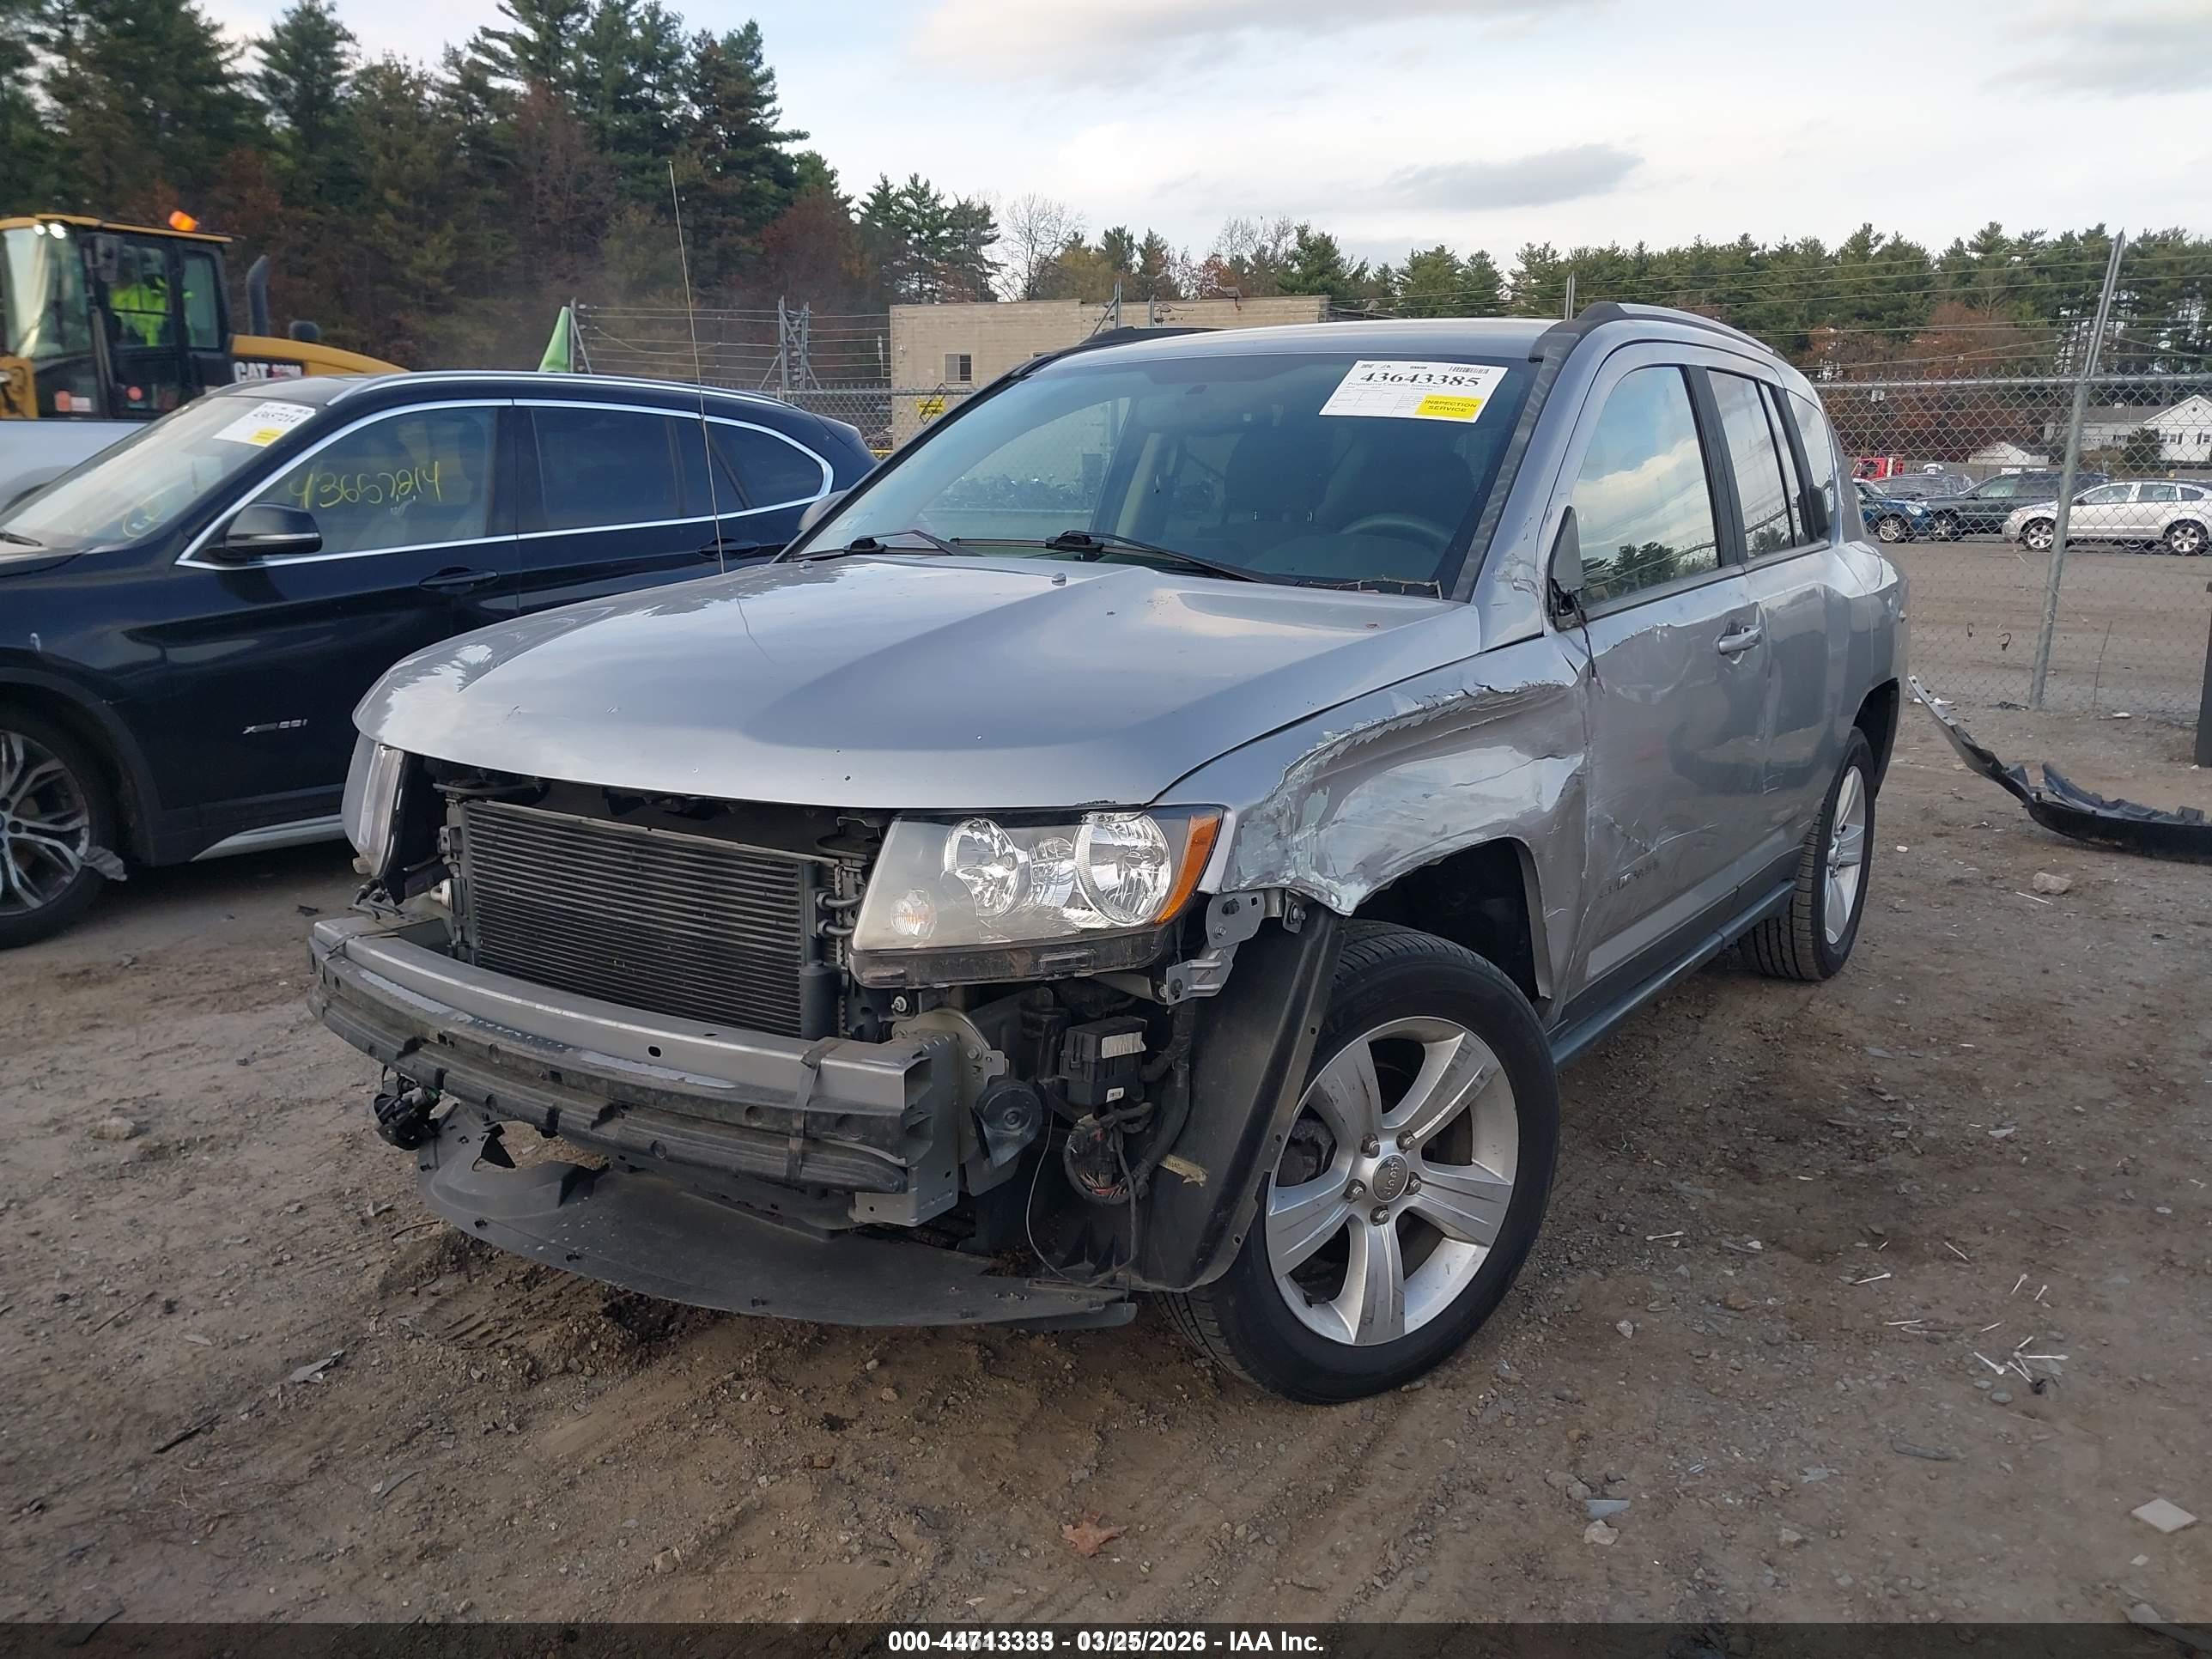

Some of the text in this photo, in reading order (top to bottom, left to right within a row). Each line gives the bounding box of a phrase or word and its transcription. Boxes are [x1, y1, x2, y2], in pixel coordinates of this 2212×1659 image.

[234, 362, 269, 382] CAT
[1360, 372, 1481, 387] 43643385
[1425, 399, 1478, 409] INSPECTION
